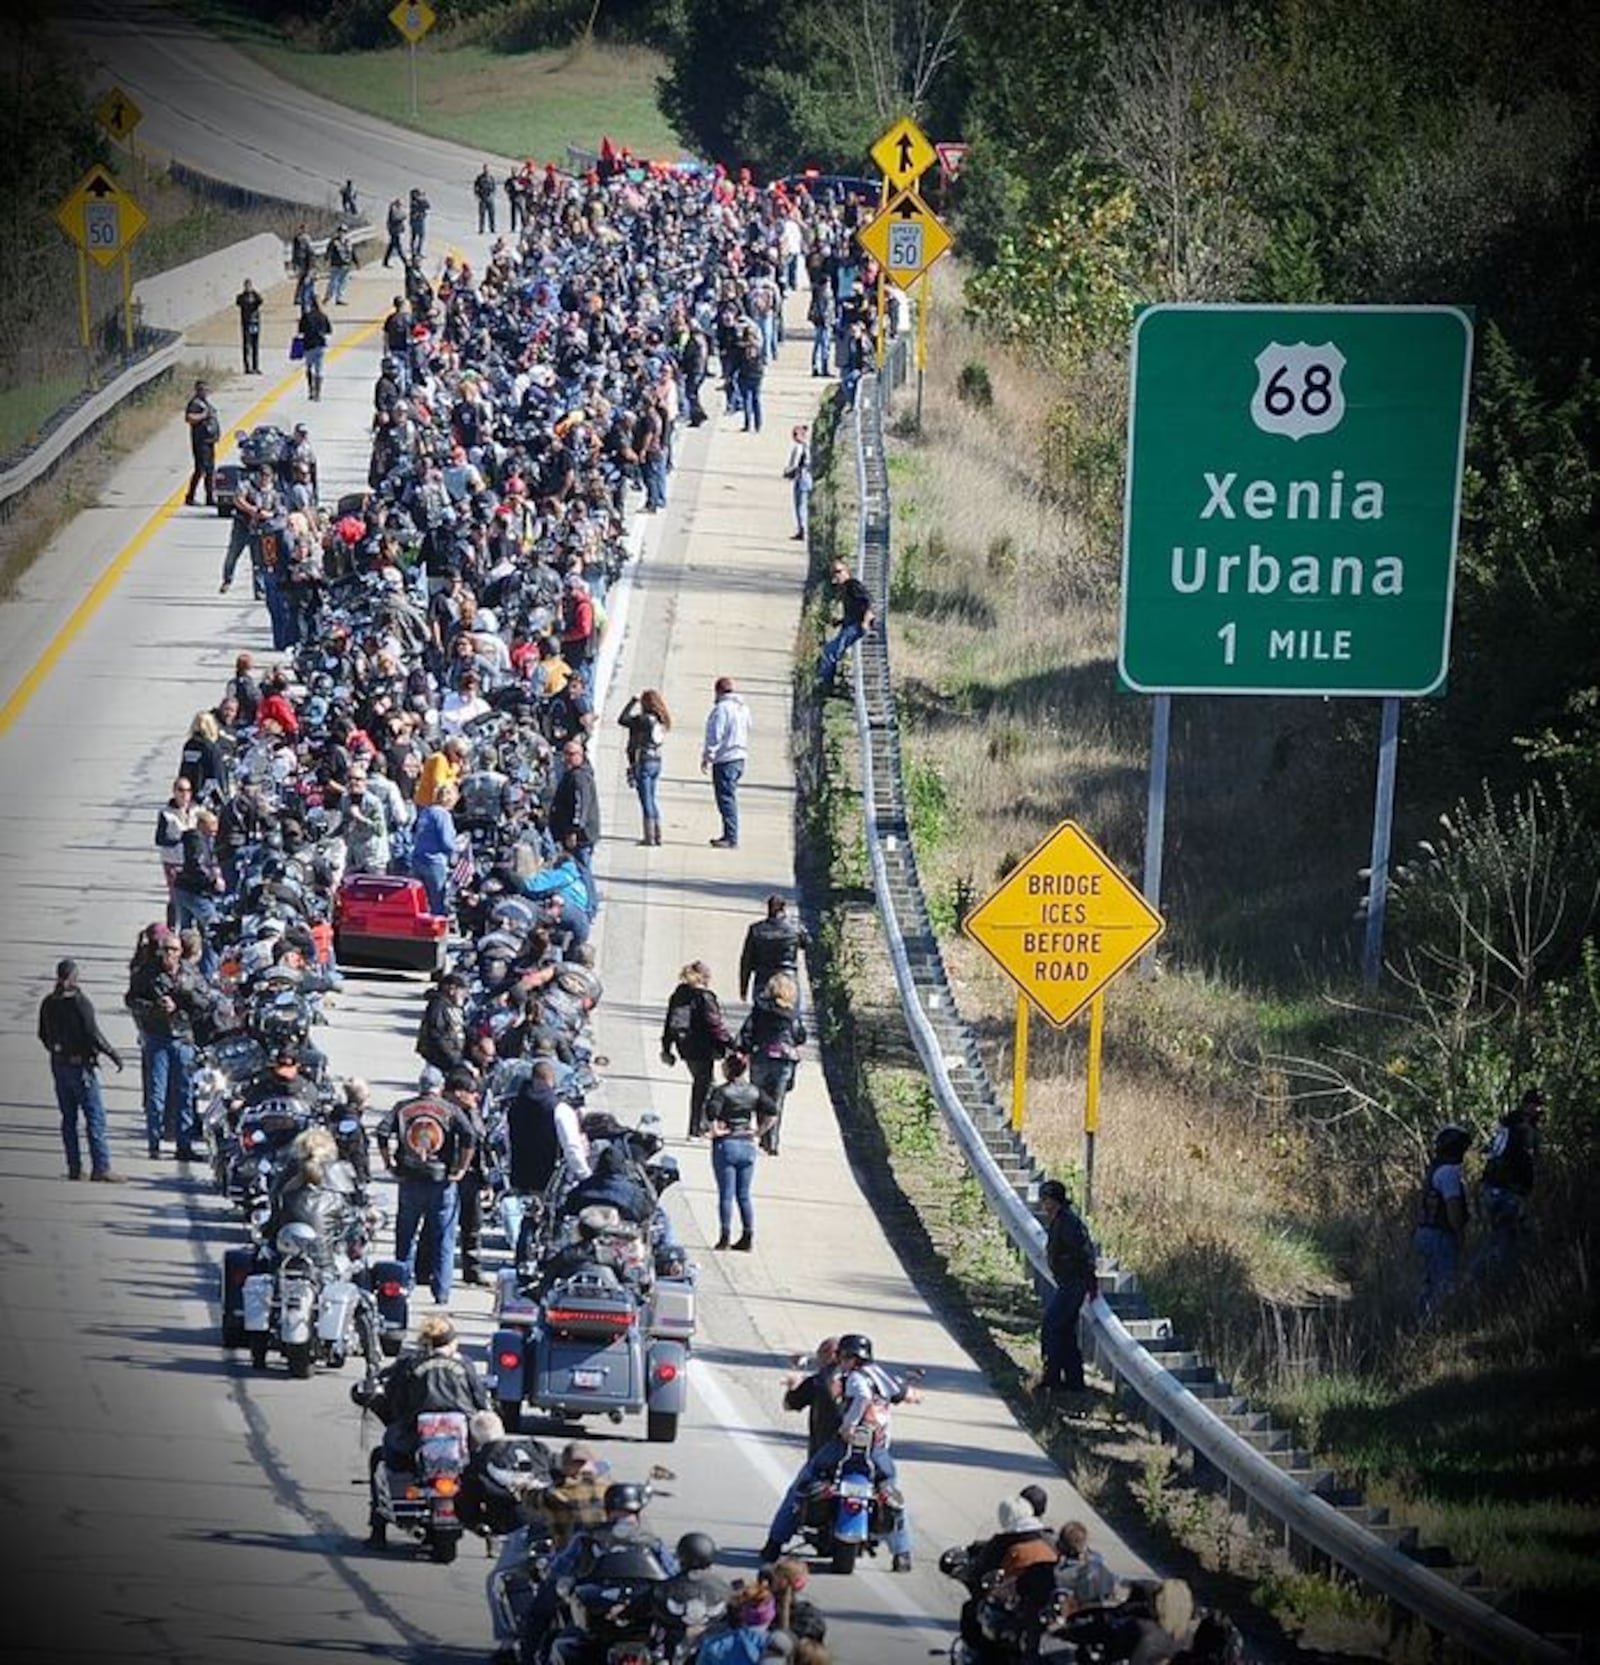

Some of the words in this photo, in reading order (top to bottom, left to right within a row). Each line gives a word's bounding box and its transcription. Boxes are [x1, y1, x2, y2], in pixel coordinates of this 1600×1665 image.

[90, 223, 114, 243] 50
[893, 244, 917, 264] 50
[1264, 364, 1332, 416] 68
[1200, 470, 1385, 520] Xenia
[1171, 545, 1404, 595] Urbana
[1217, 621, 1237, 665] 1
[1269, 629, 1352, 659] MILE
[1028, 874, 1101, 895] BRIDGE
[1042, 903, 1086, 924] ICES
[1024, 932, 1101, 953] BEFORE
[1035, 961, 1089, 982] ROAD
